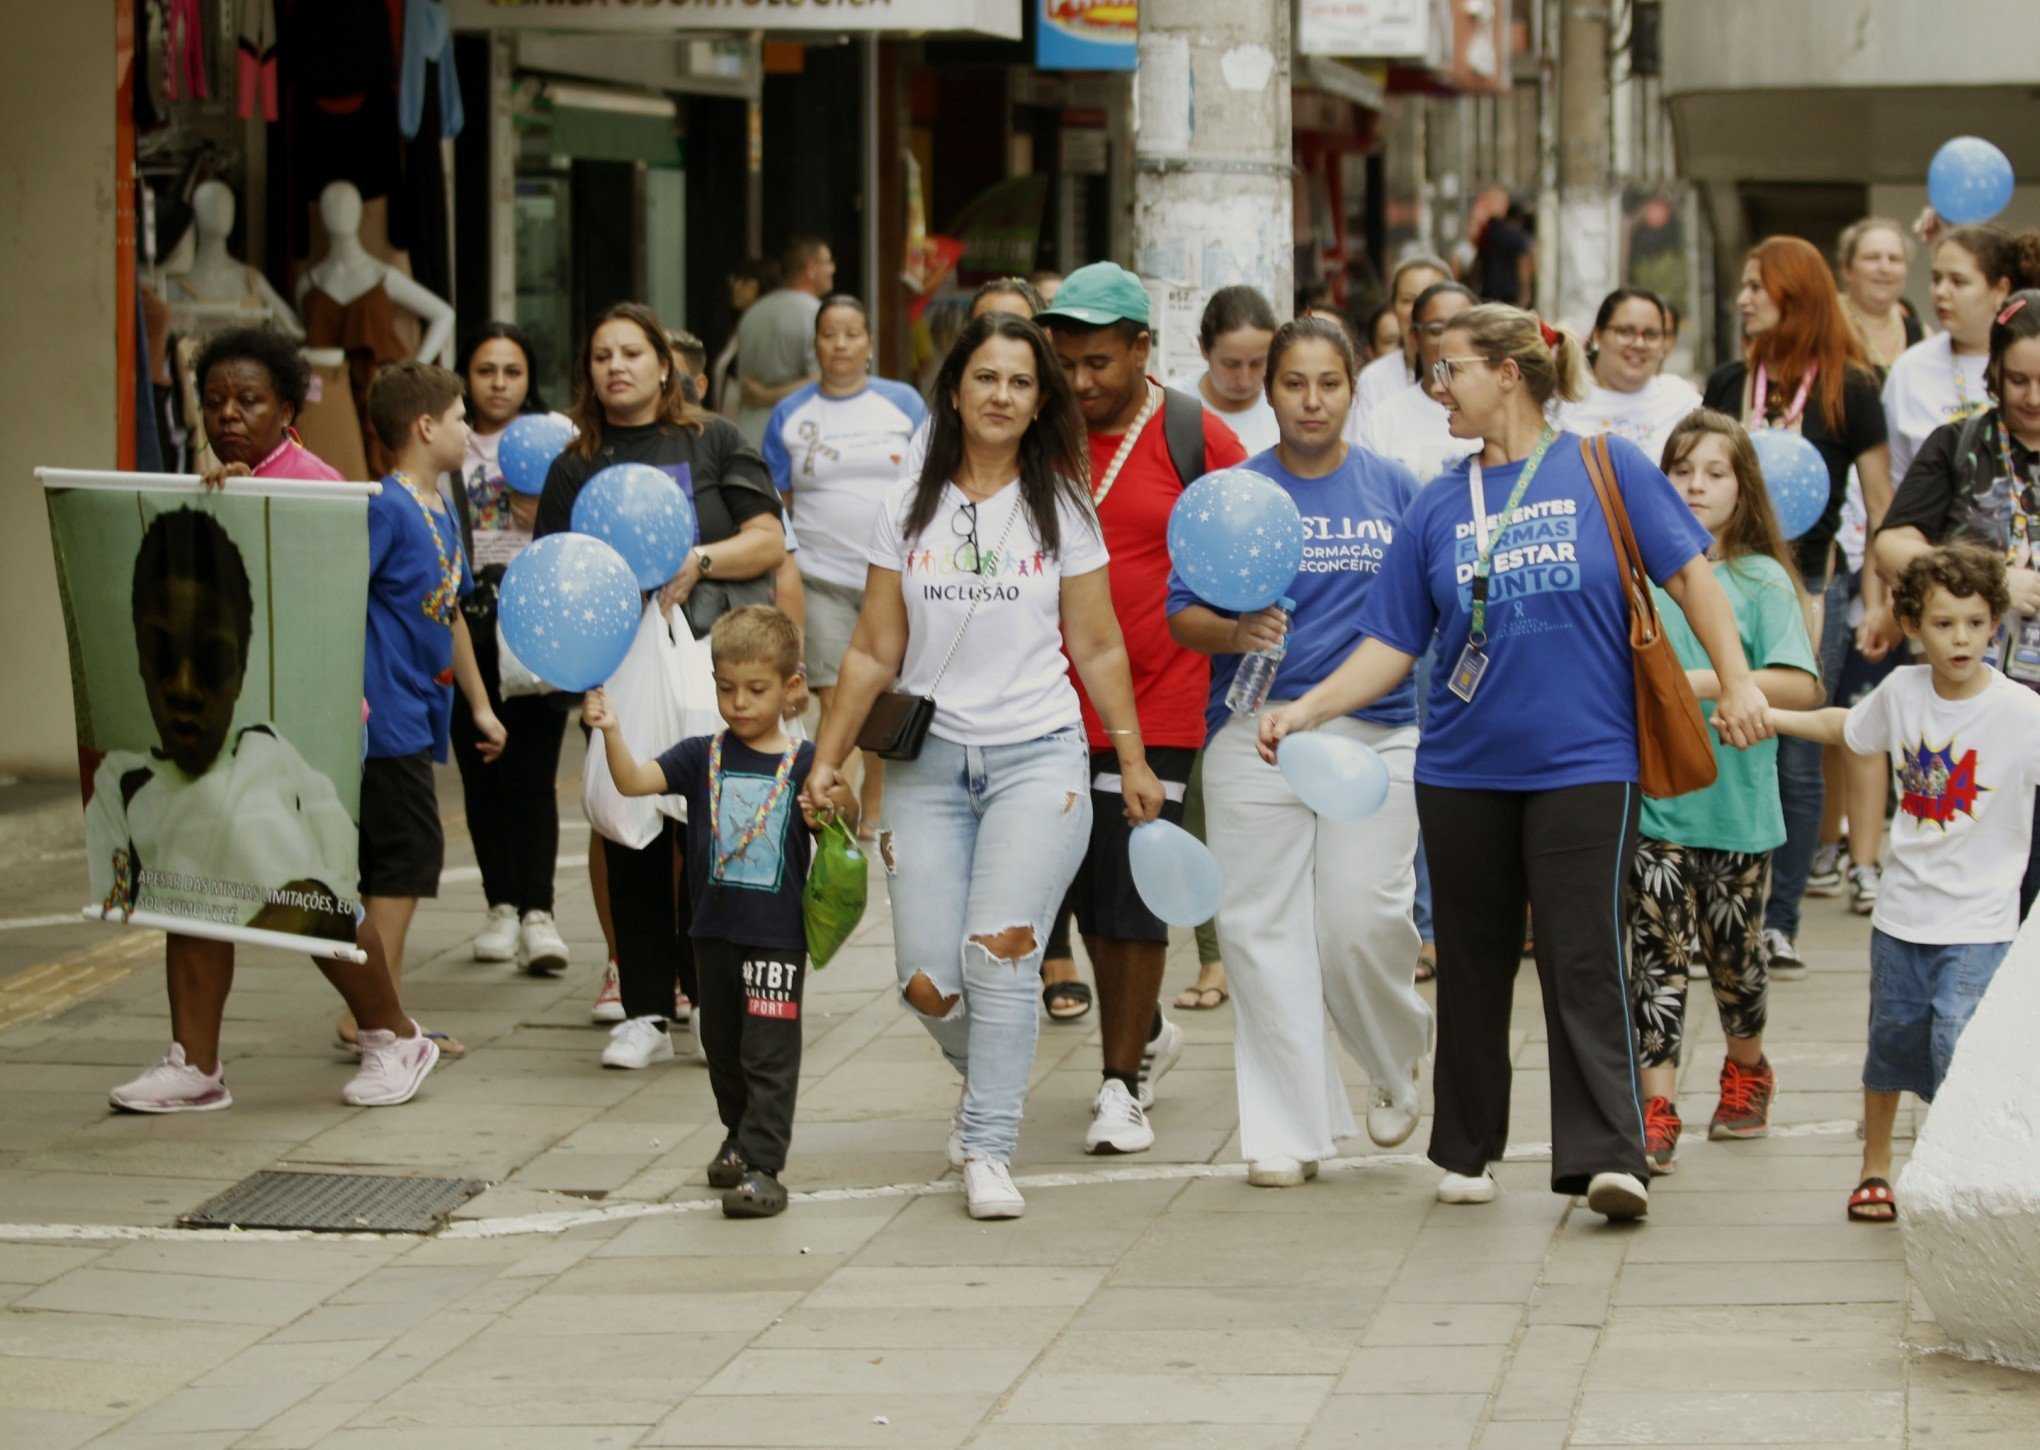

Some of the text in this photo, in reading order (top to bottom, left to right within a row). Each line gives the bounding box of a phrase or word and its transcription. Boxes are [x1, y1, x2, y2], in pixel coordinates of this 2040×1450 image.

[1456, 499, 1577, 539] DIEENTES
[1302, 543, 1383, 559] ORMAÇÃO
[1460, 520, 1571, 559] FRMAS
[1298, 558, 1382, 574] ECONCEITO
[1493, 542, 1577, 574] ESTAR
[1466, 566, 1575, 606] UNTO
[138, 869, 353, 915] APESAR DAS MINHAS LIMITAÇÕES, EU
[139, 895, 163, 912] SOU
[165, 899, 202, 919] COMO
[742, 961, 798, 991] #TBT
[748, 999, 784, 1017] SPORT
